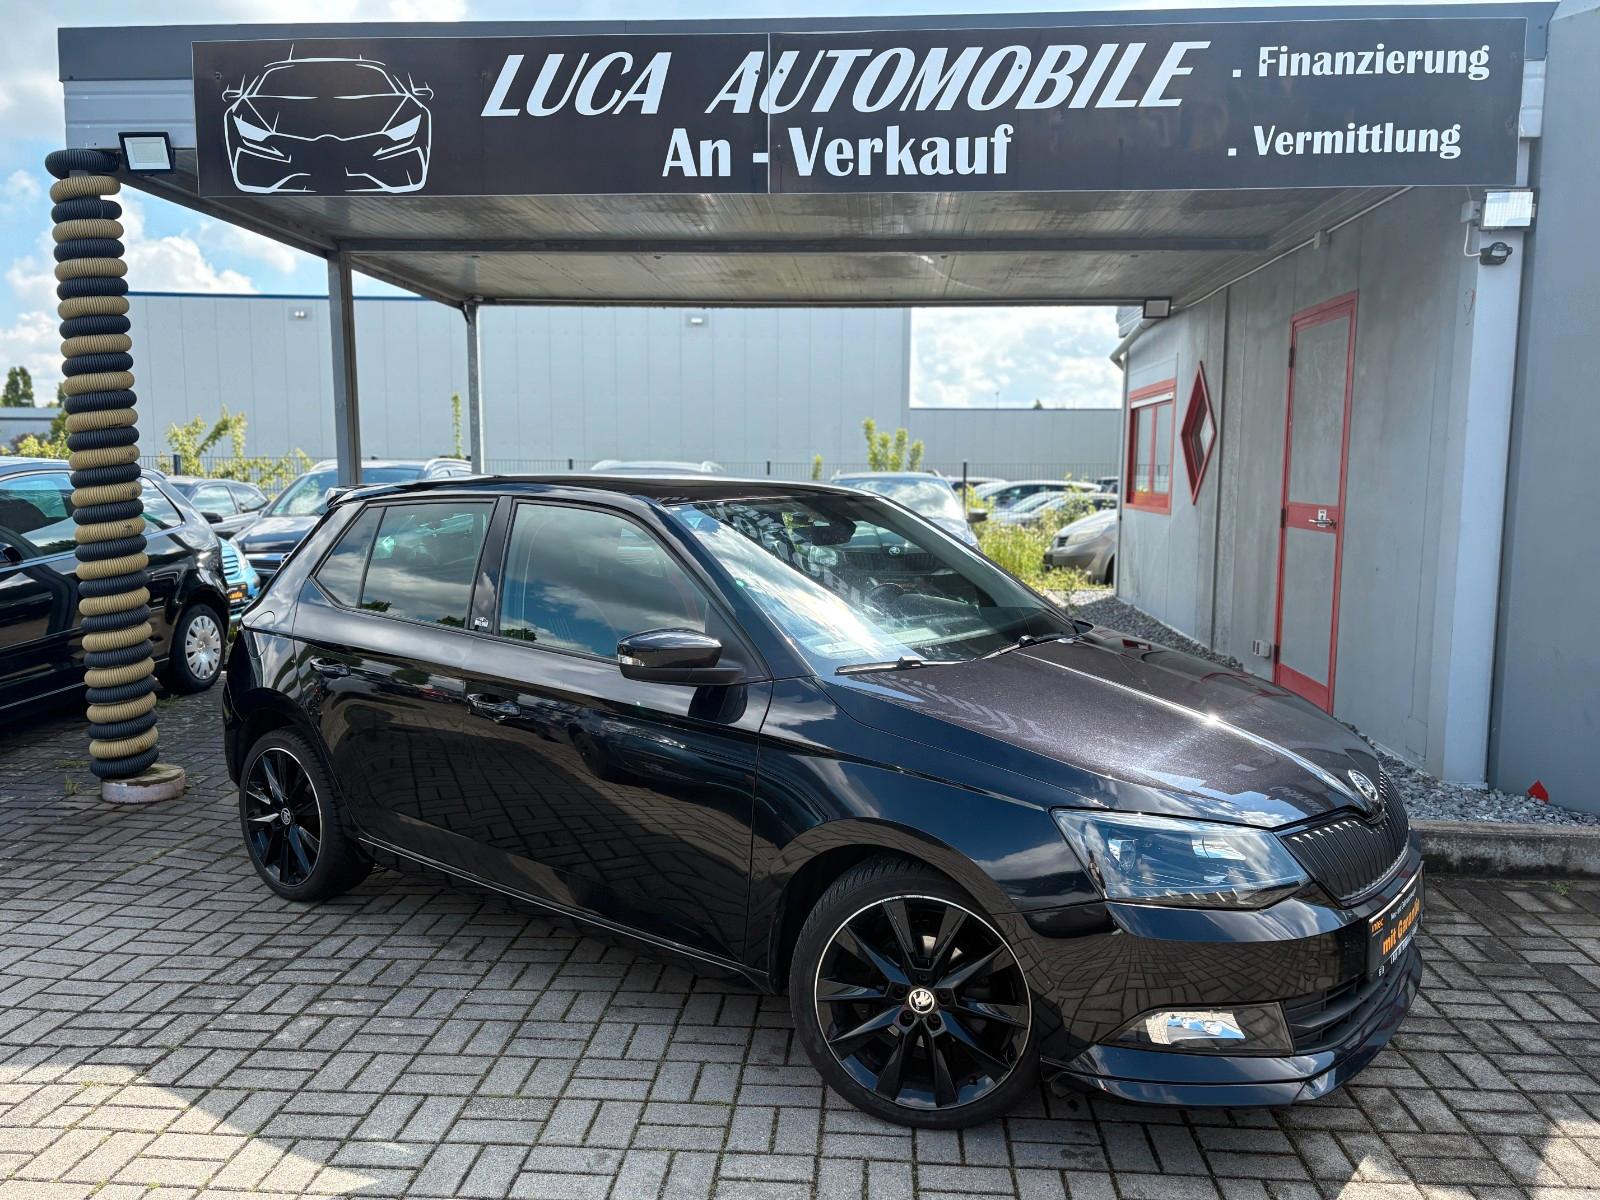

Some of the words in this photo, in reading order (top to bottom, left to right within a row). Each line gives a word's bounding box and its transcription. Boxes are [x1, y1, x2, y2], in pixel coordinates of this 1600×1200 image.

[480, 52, 672, 117] LUCA
[703, 40, 1212, 114] AUTOMOBILE
[1258, 43, 1490, 81] Finanzierung
[661, 128, 731, 177] An
[787, 123, 1014, 178] Verkauf
[1253, 122, 1462, 160] Vermittlung
